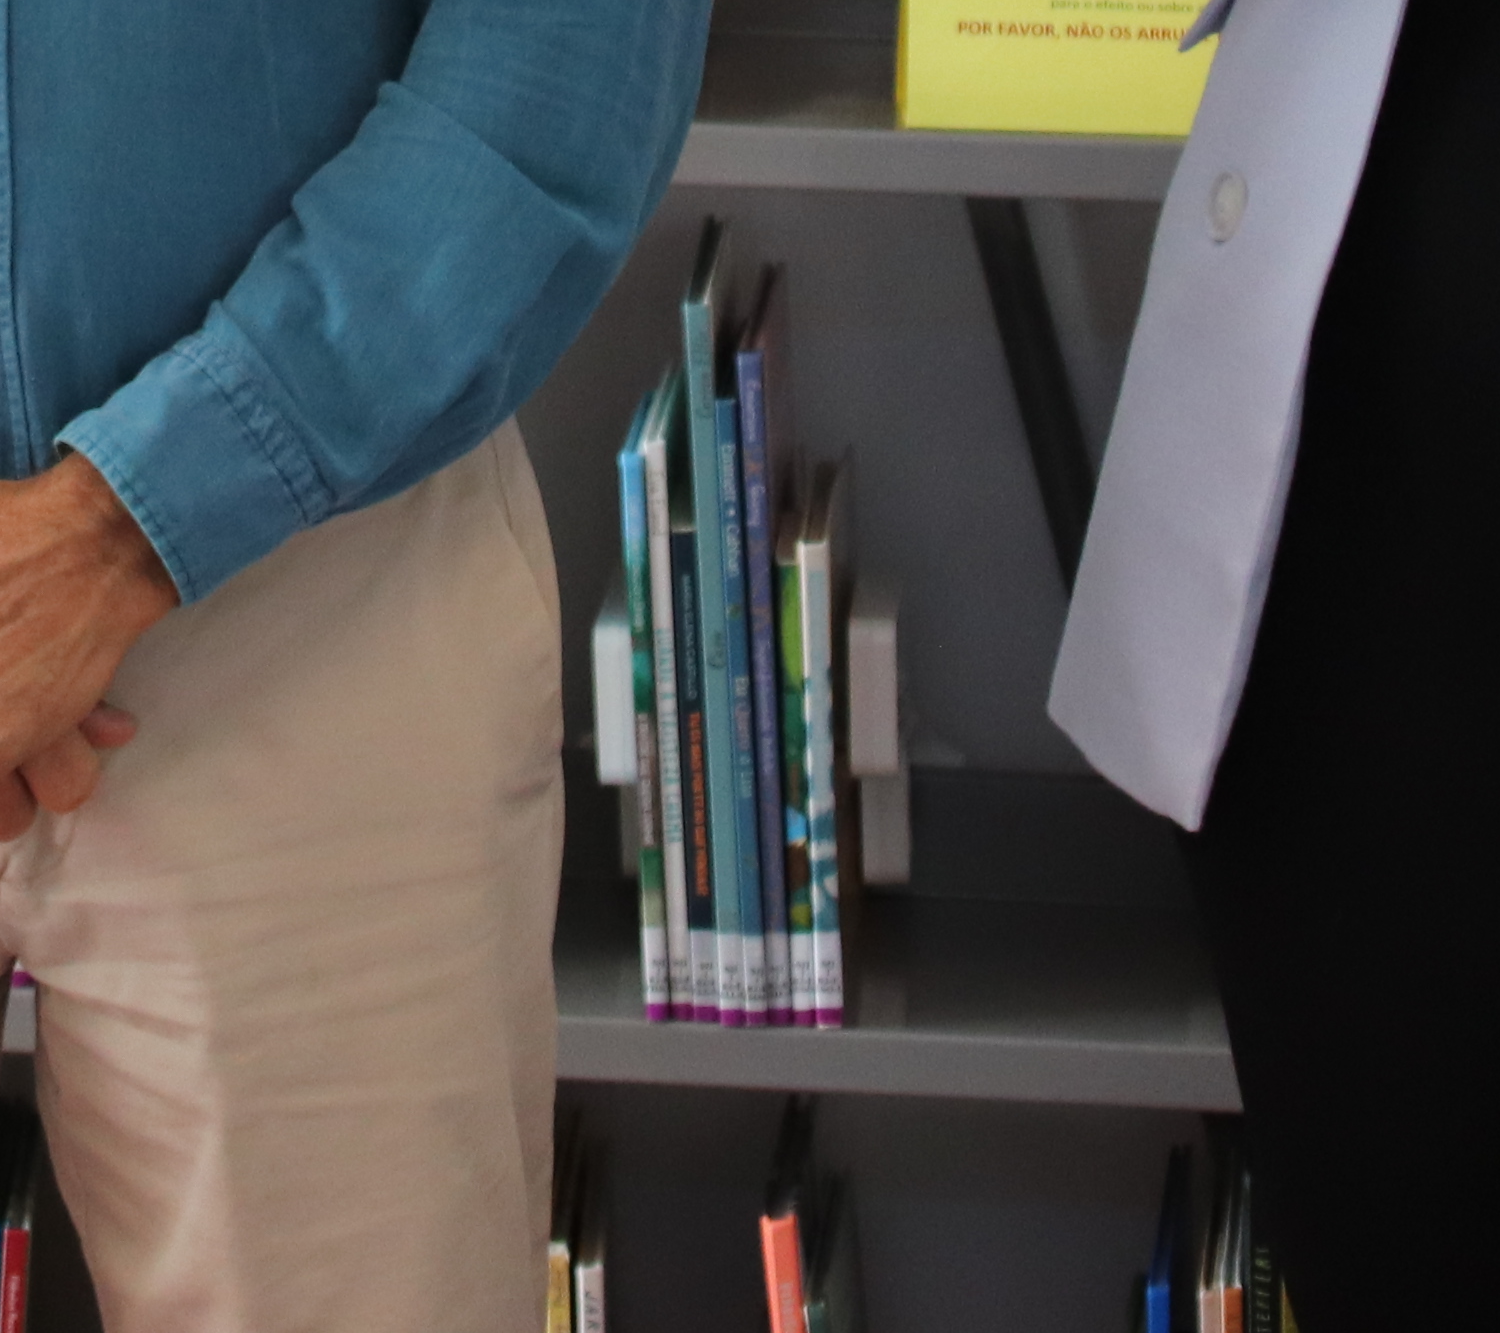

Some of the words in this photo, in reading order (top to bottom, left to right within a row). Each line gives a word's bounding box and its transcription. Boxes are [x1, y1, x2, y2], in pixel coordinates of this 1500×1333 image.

[958, 20, 993, 35] POR
[999, 22, 1061, 40] FAVOR,
[1067, 20, 1104, 39] NÃO
[1110, 24, 1133, 40] OS
[1137, 26, 1208, 41] ARRU
